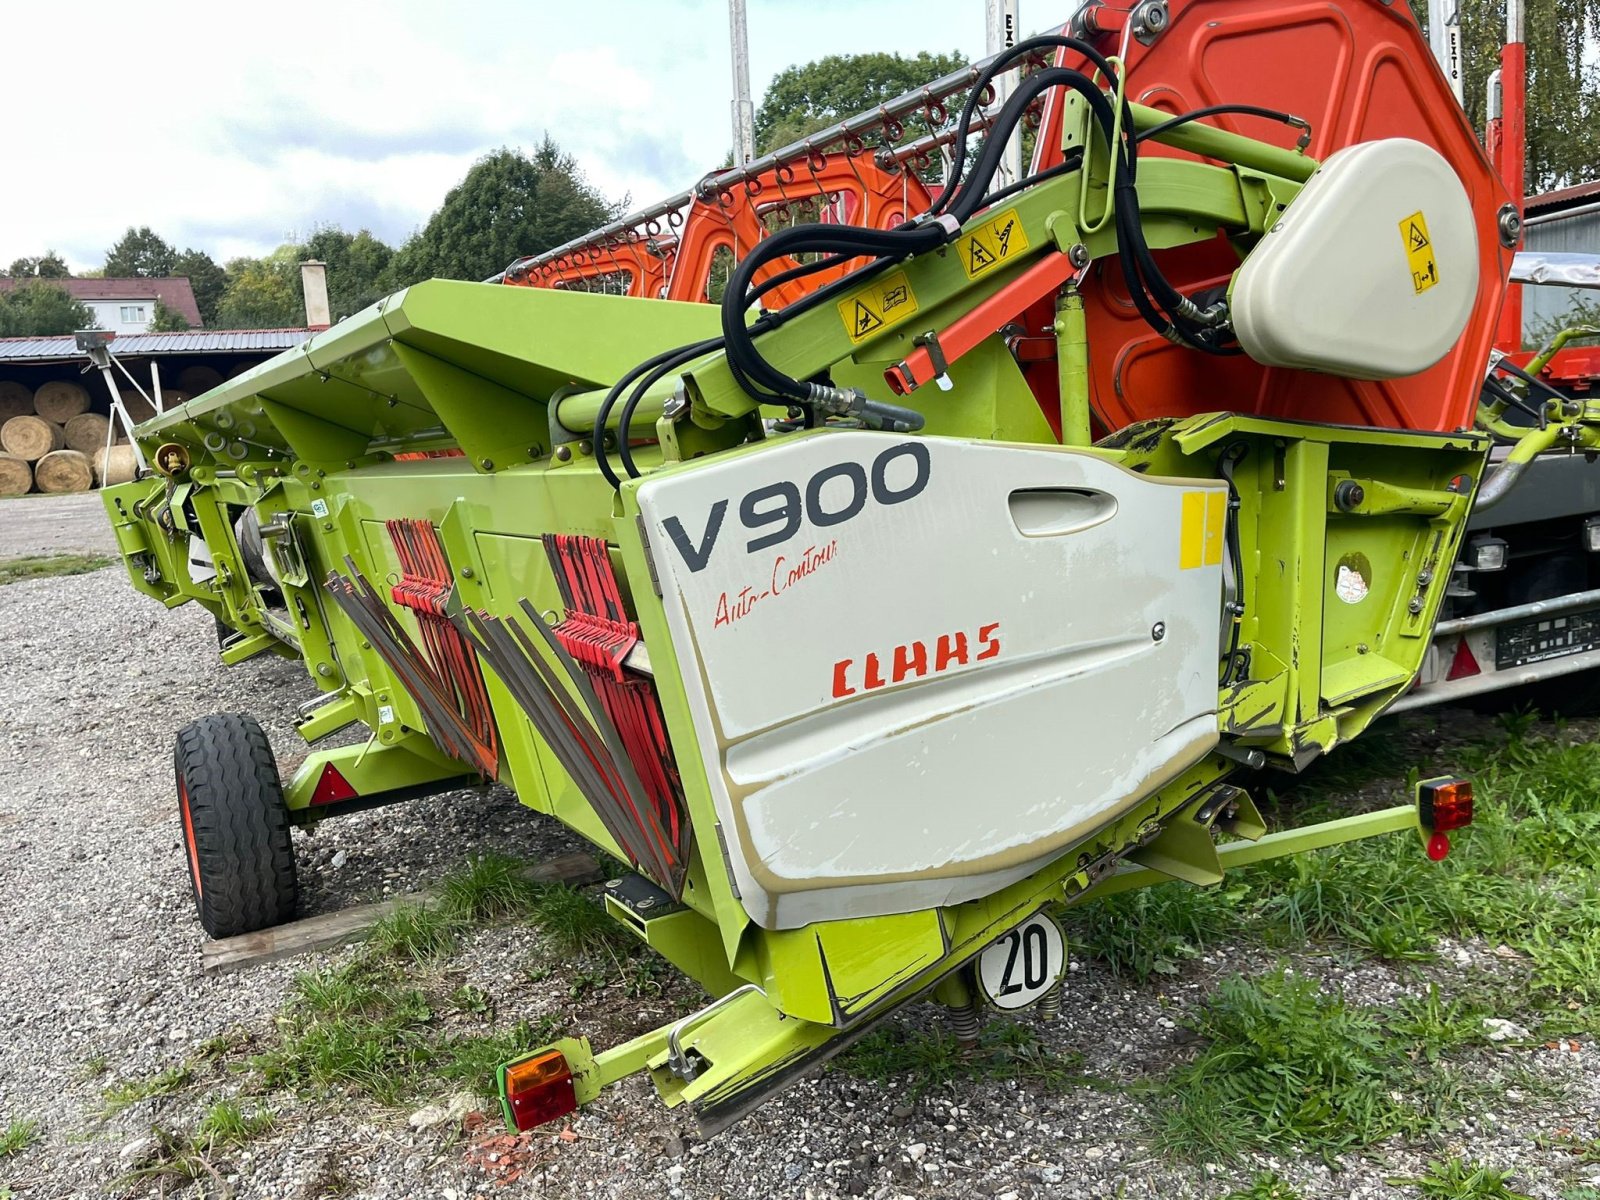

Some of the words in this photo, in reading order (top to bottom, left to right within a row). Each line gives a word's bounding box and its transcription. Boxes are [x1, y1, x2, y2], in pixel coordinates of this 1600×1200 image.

[713, 539, 839, 630] Auto-Contour
[832, 622, 1001, 698] CLAAS
[996, 923, 1048, 997] 20
